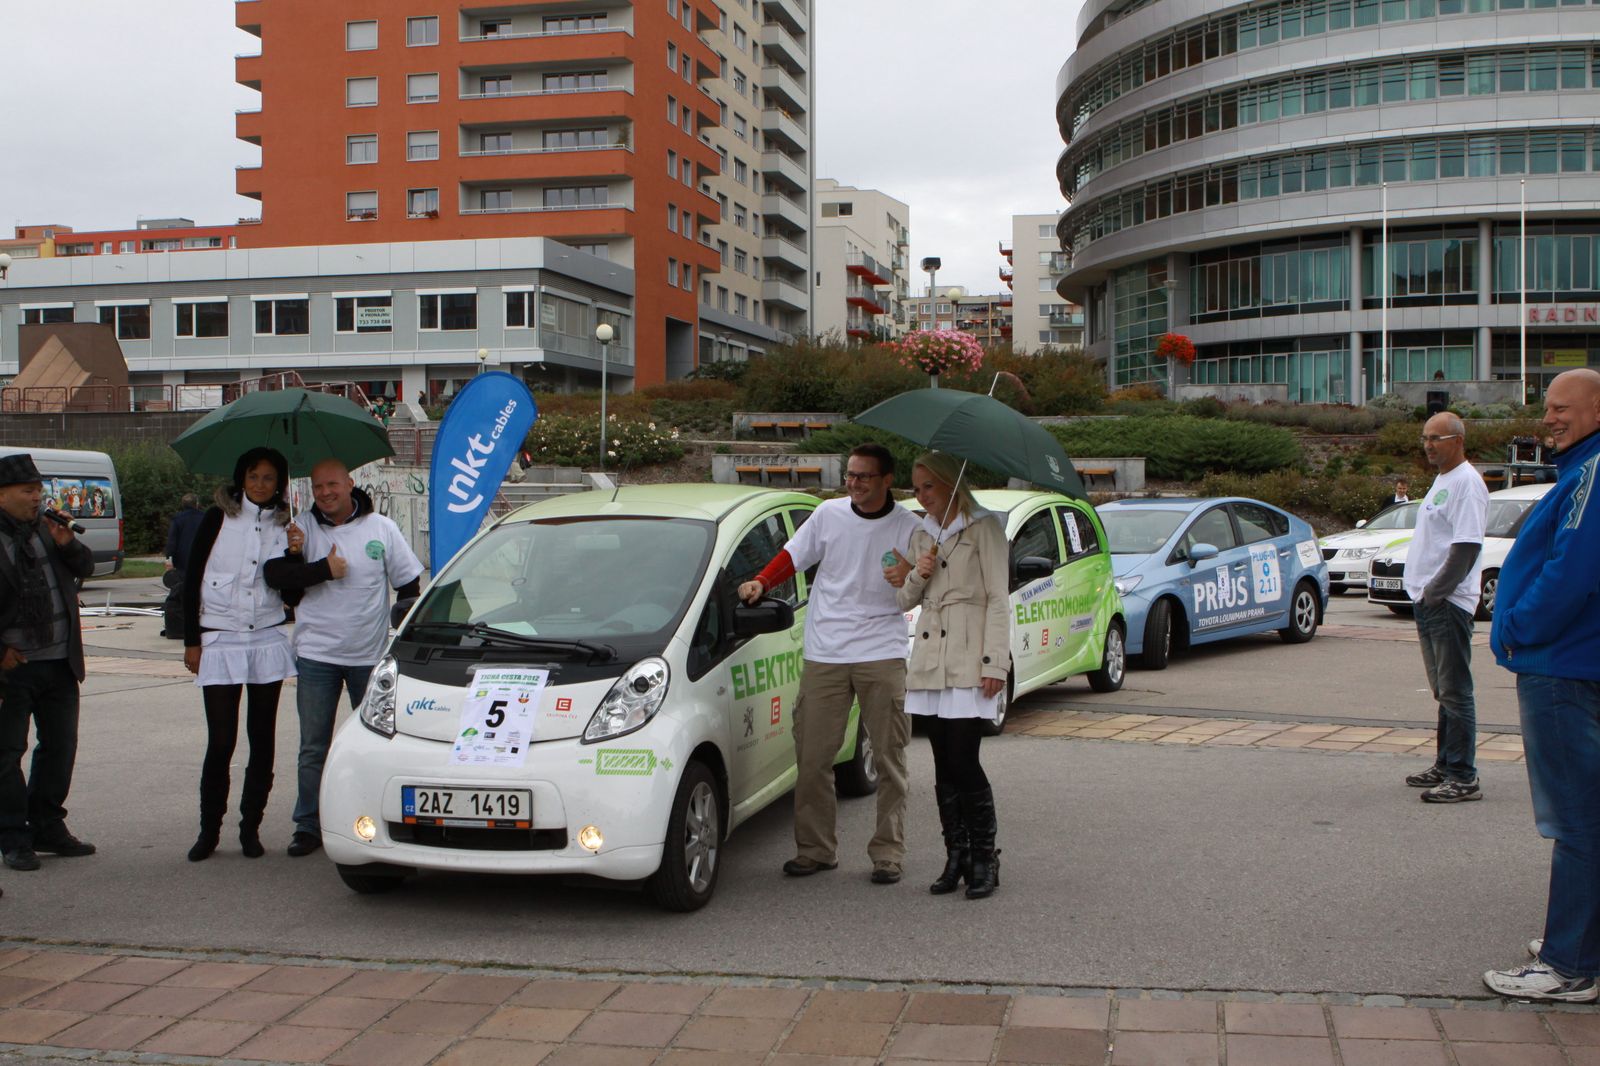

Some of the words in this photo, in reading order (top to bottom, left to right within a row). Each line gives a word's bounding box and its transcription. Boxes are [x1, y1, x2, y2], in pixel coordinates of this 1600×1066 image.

[447, 433, 496, 507] nkt
[491, 399, 517, 440] cables
[1251, 549, 1276, 561] PLUG-IN
[1016, 594, 1091, 625] ELEKTROMOBIL
[1198, 615, 1219, 627] TOYOTA
[1247, 607, 1265, 618] PRAHA
[408, 697, 436, 713] nkt
[485, 700, 508, 728] 5
[419, 792, 453, 814] 2AZ
[470, 793, 520, 816] 1419
